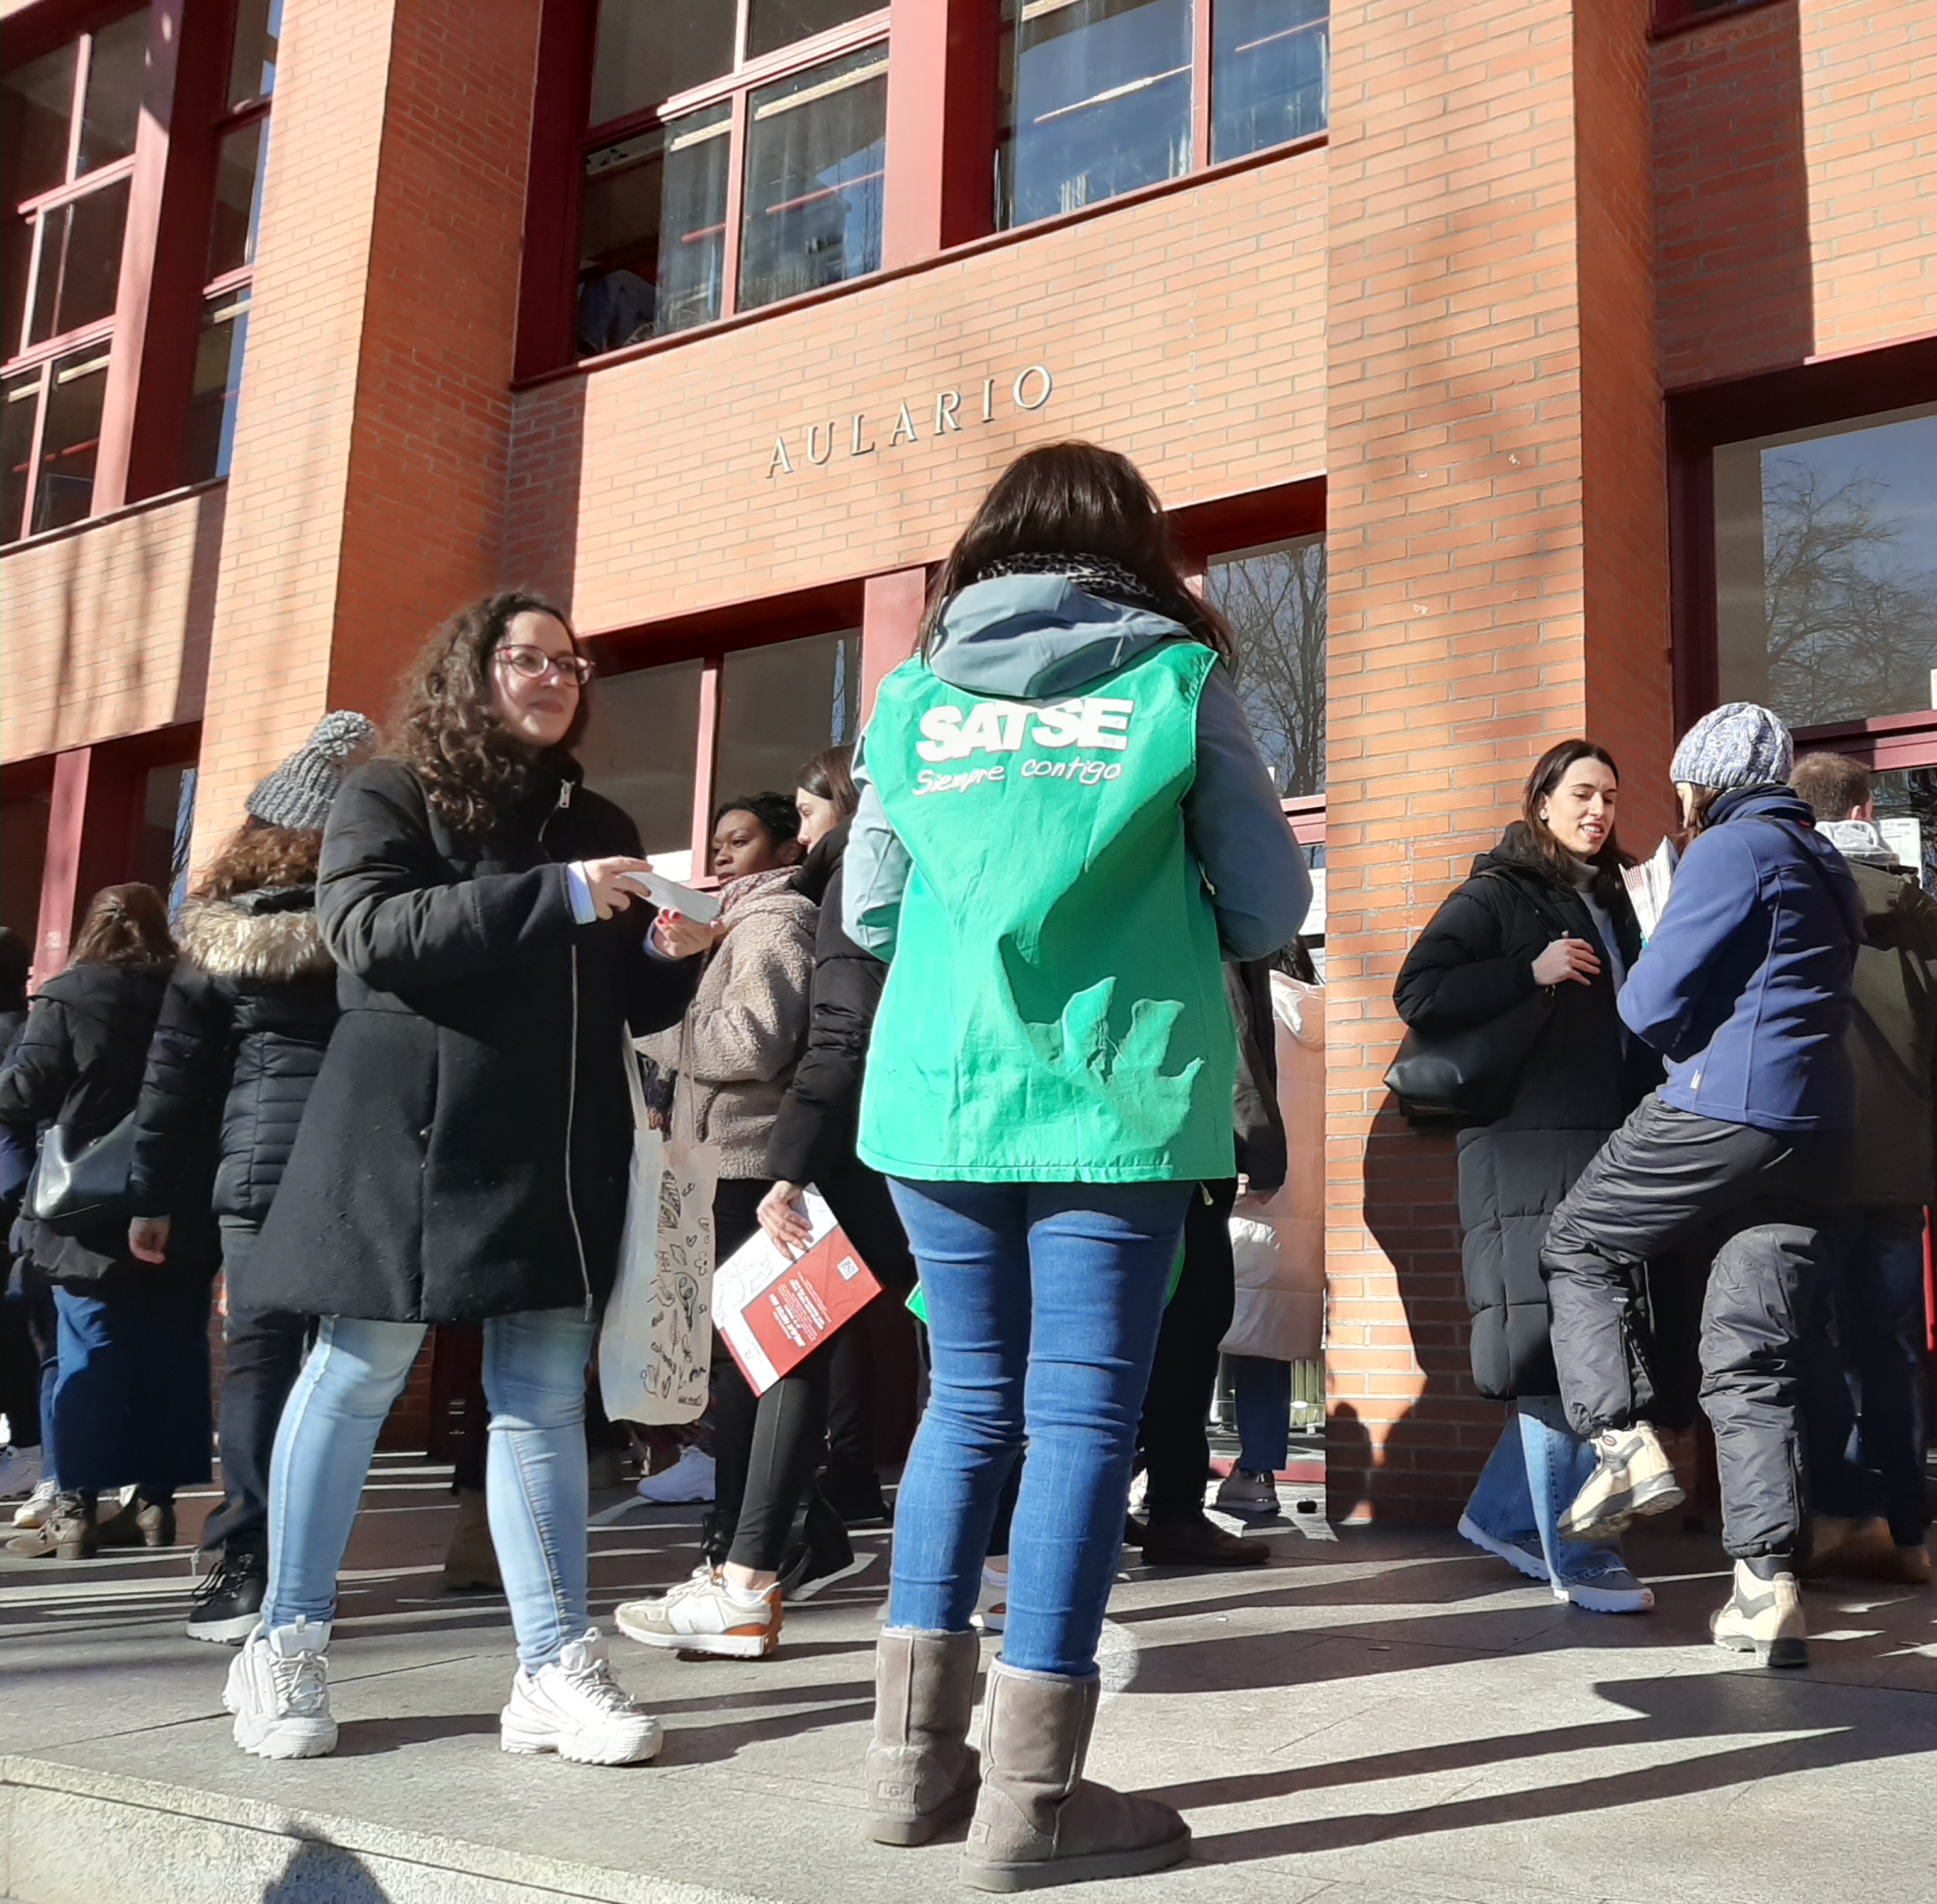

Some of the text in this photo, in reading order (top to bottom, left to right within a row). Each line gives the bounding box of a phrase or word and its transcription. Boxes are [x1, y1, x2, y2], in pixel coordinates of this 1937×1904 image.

[765, 364, 1053, 479] AULARIO
[916, 697, 1134, 762] SATSE
[912, 756, 1122, 796] Siempre contigo
